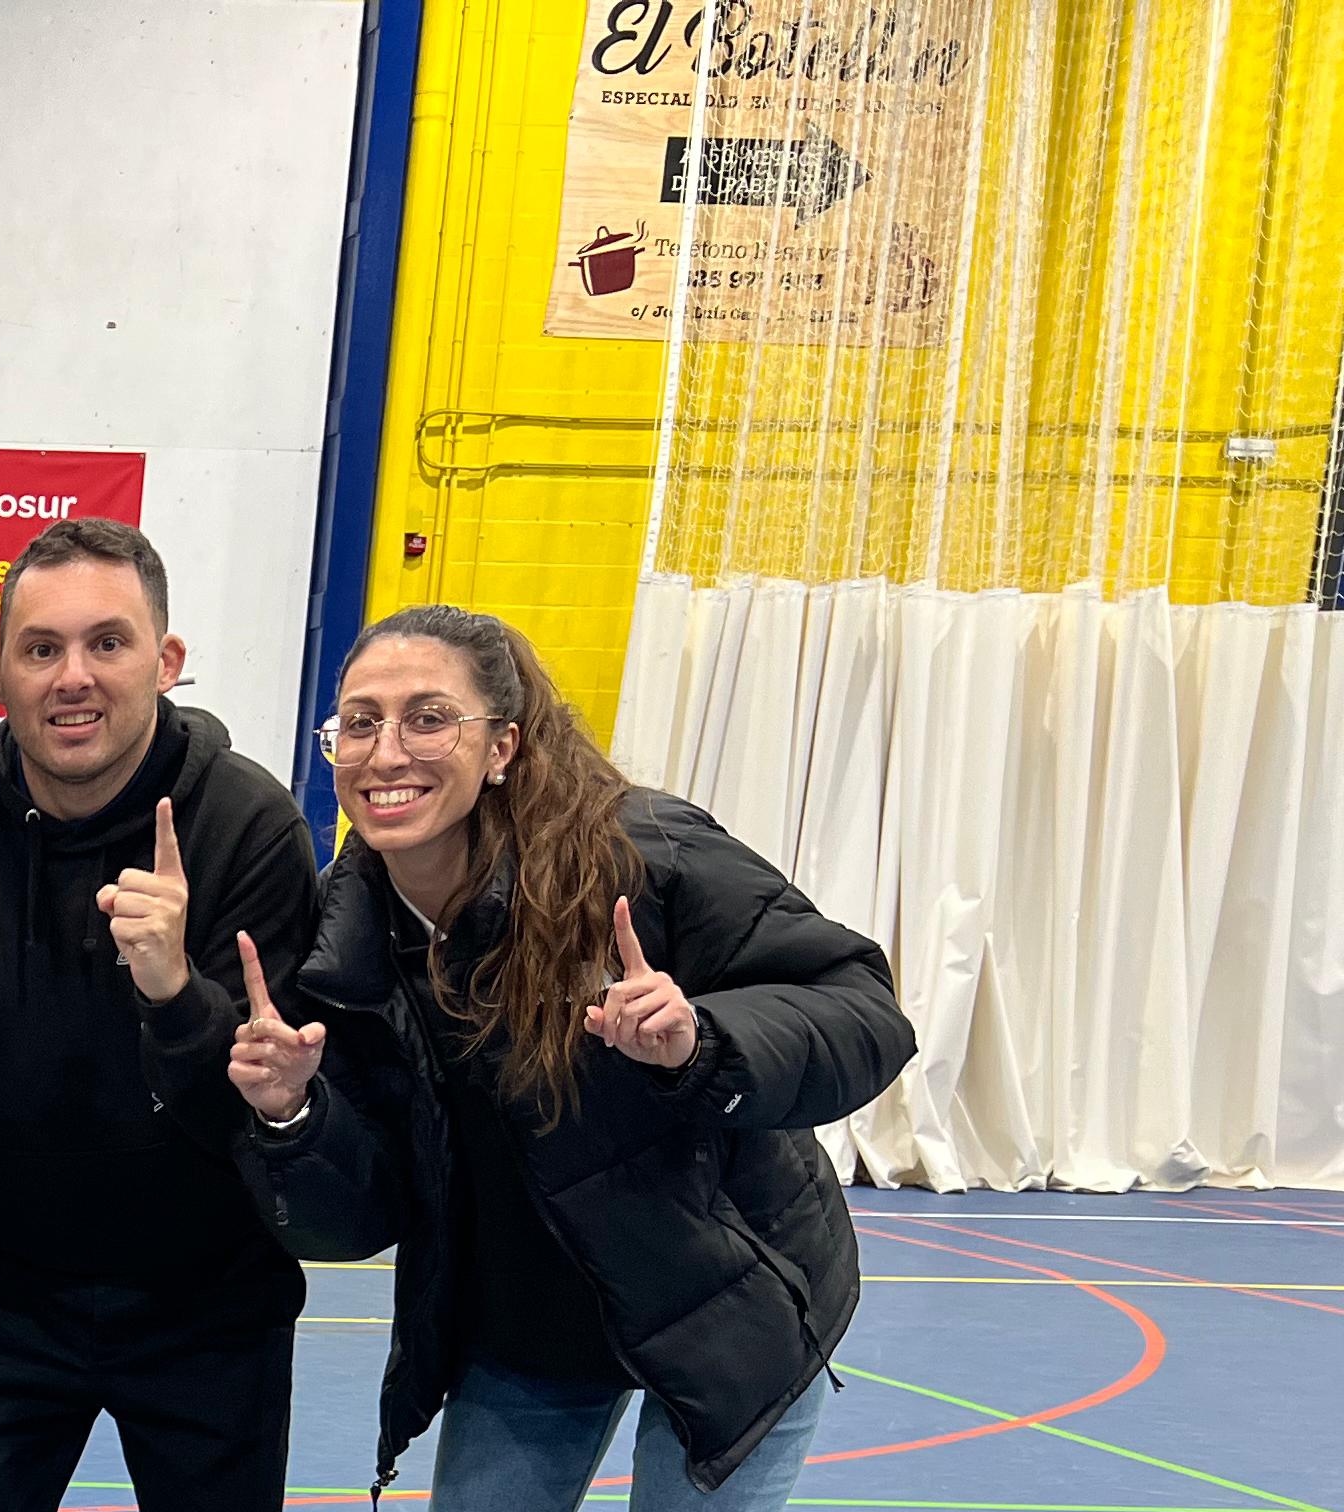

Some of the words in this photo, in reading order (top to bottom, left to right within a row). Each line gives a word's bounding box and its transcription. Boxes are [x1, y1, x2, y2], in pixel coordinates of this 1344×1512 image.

[601, 90, 738, 109] ESPECIALDAD
[671, 175, 712, 192] DL
[655, 238, 748, 261] Teéfono
